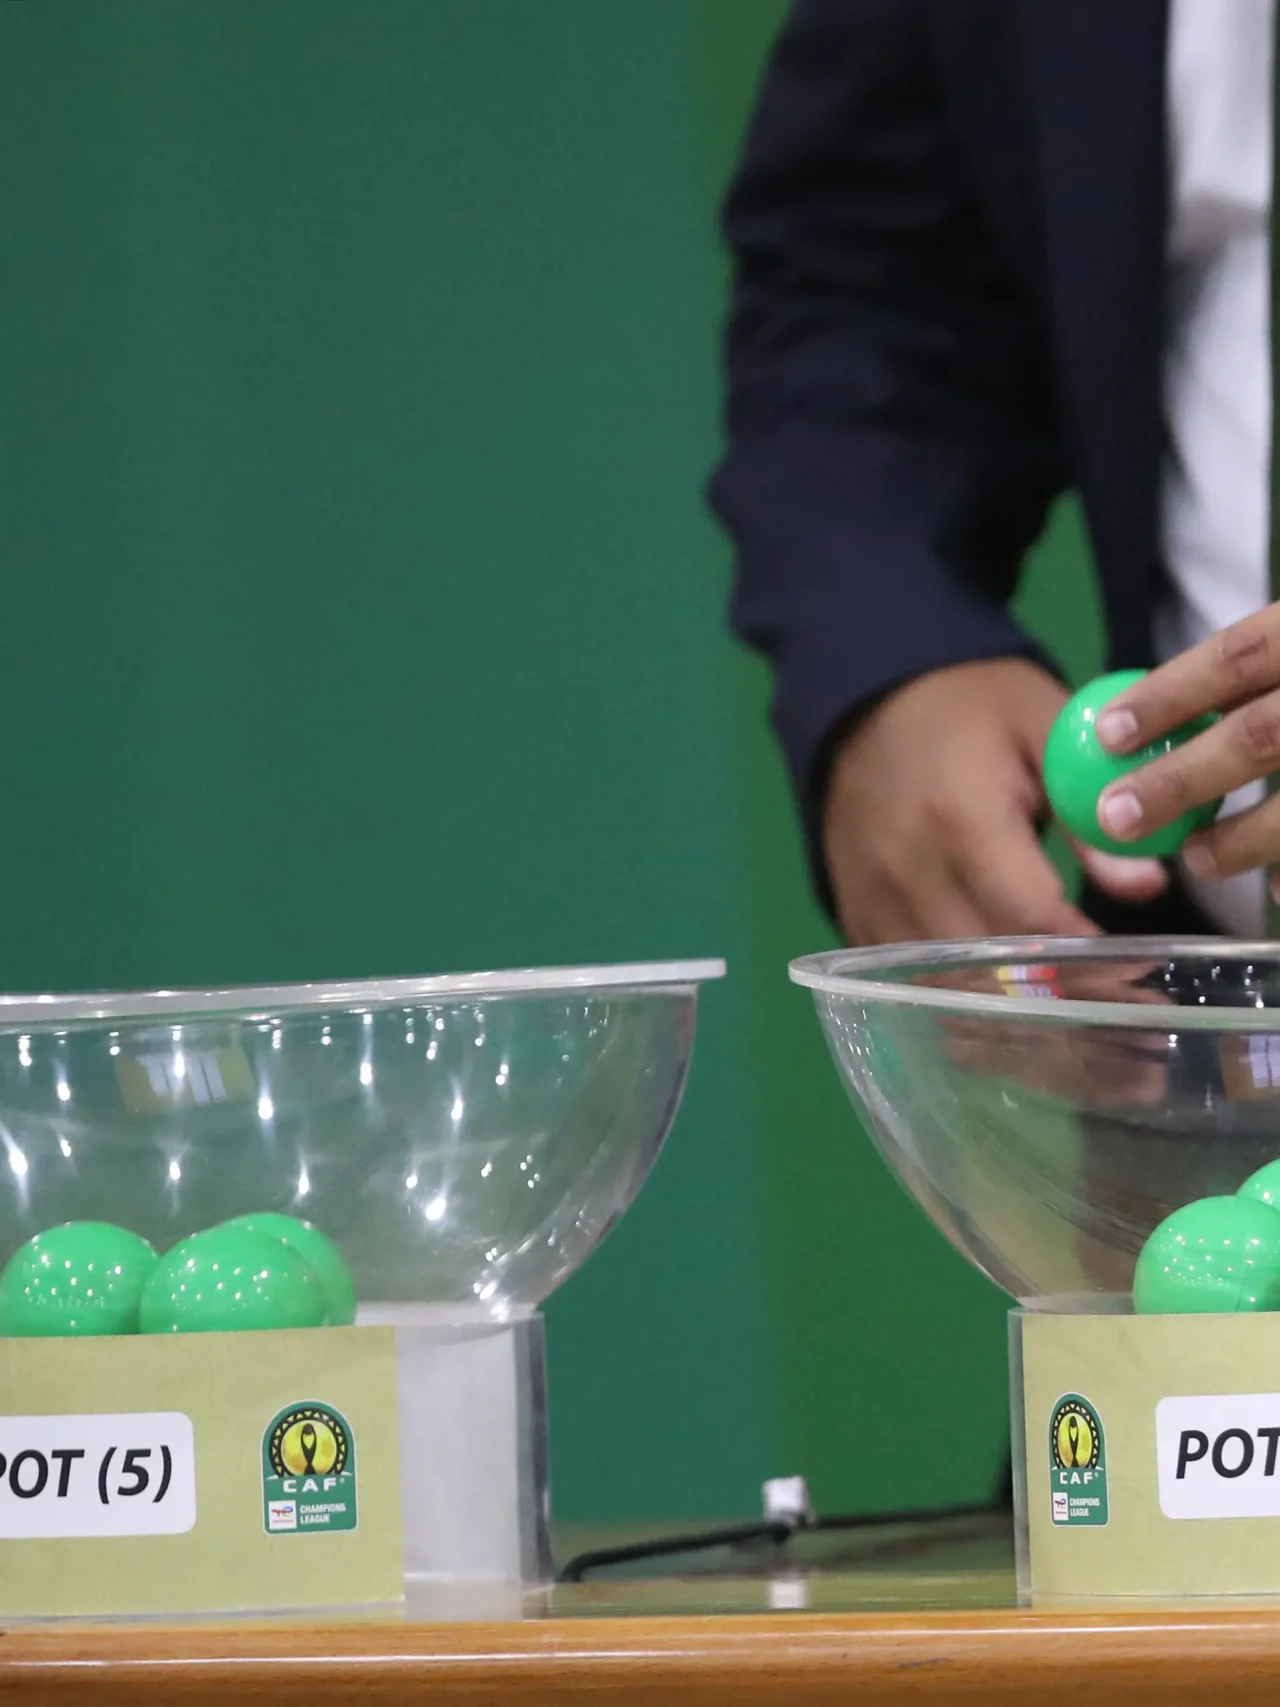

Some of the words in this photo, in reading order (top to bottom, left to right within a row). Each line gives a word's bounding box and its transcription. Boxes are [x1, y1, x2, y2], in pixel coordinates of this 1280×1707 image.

[0, 1449, 85, 1498] OT
[98, 1445, 172, 1504] (5)
[1060, 1471, 1093, 1485] CAF
[283, 1477, 337, 1493] CAF
[300, 1502, 346, 1514] CHAMPIONS
[300, 1513, 330, 1525] LEAGUE
